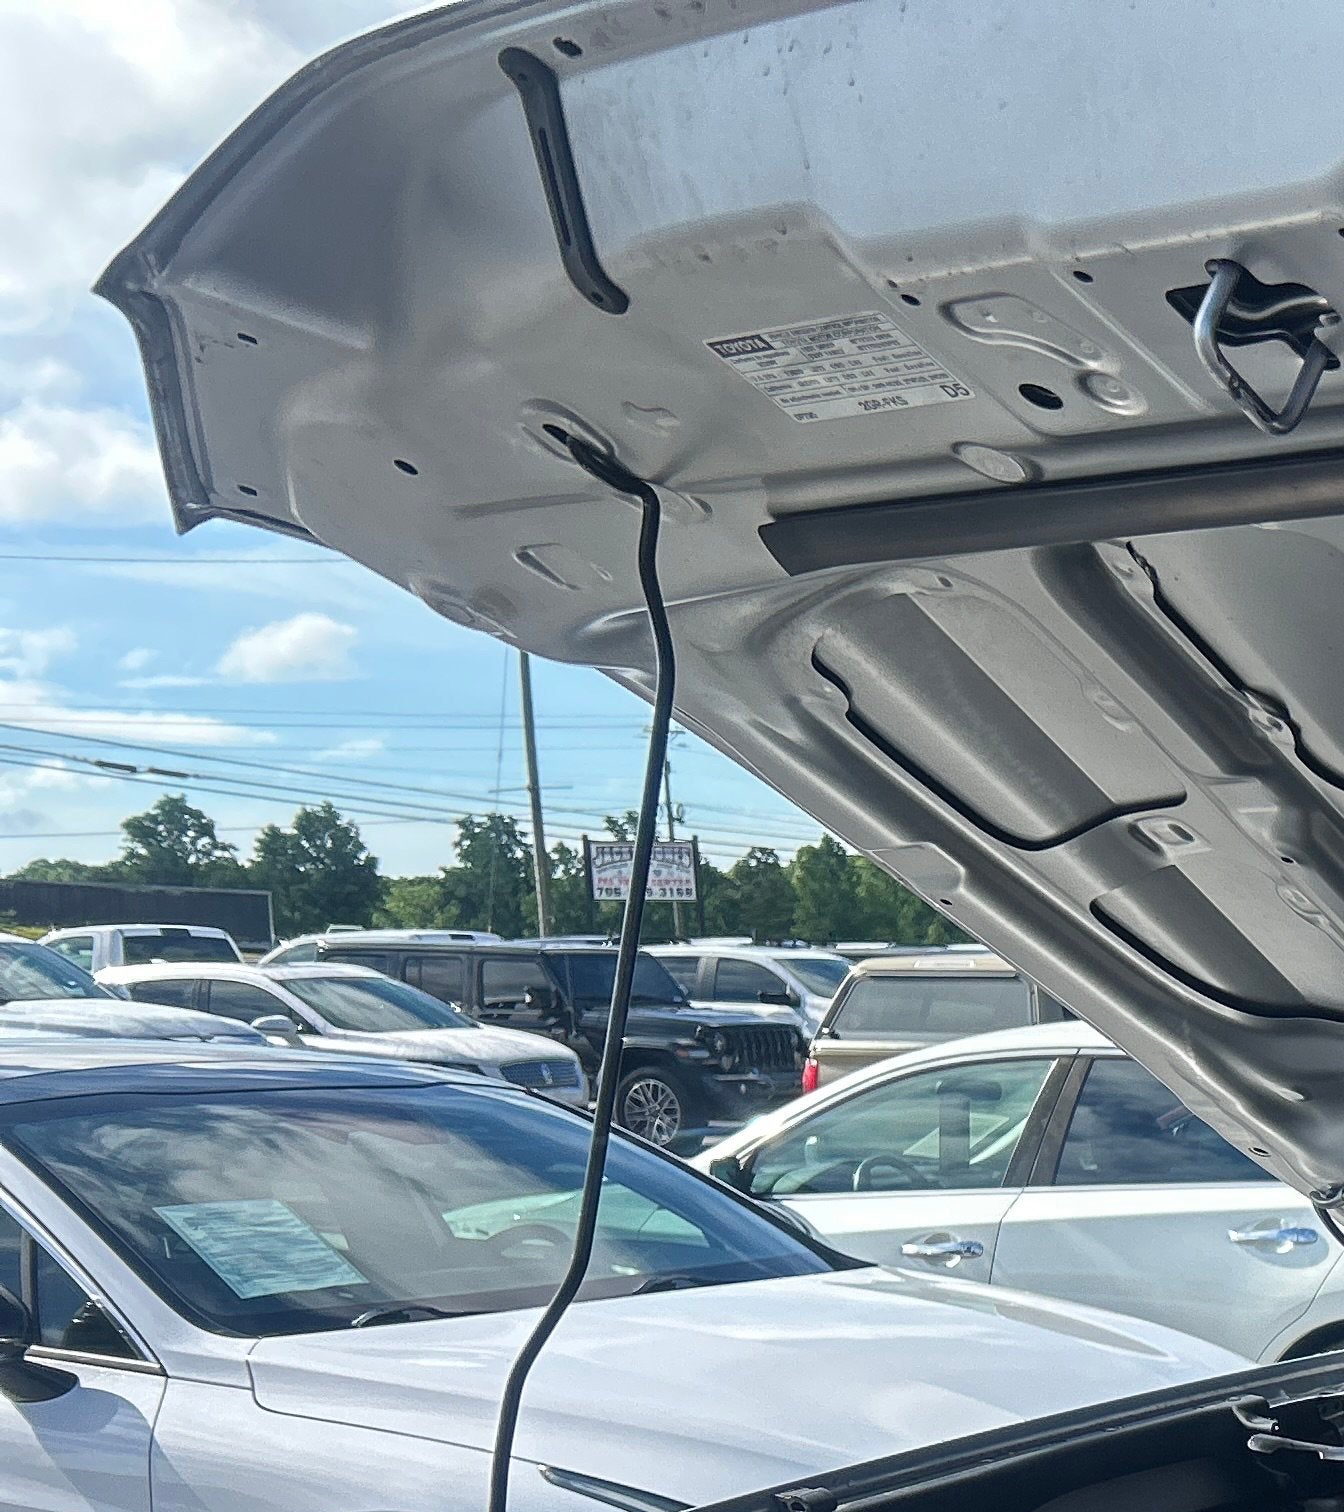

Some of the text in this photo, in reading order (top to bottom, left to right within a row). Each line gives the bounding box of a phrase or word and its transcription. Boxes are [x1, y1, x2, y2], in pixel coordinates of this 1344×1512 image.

[713, 338, 769, 355] TOYOTA
[939, 383, 970, 398] D5
[858, 396, 909, 411] 2GR-FKS
